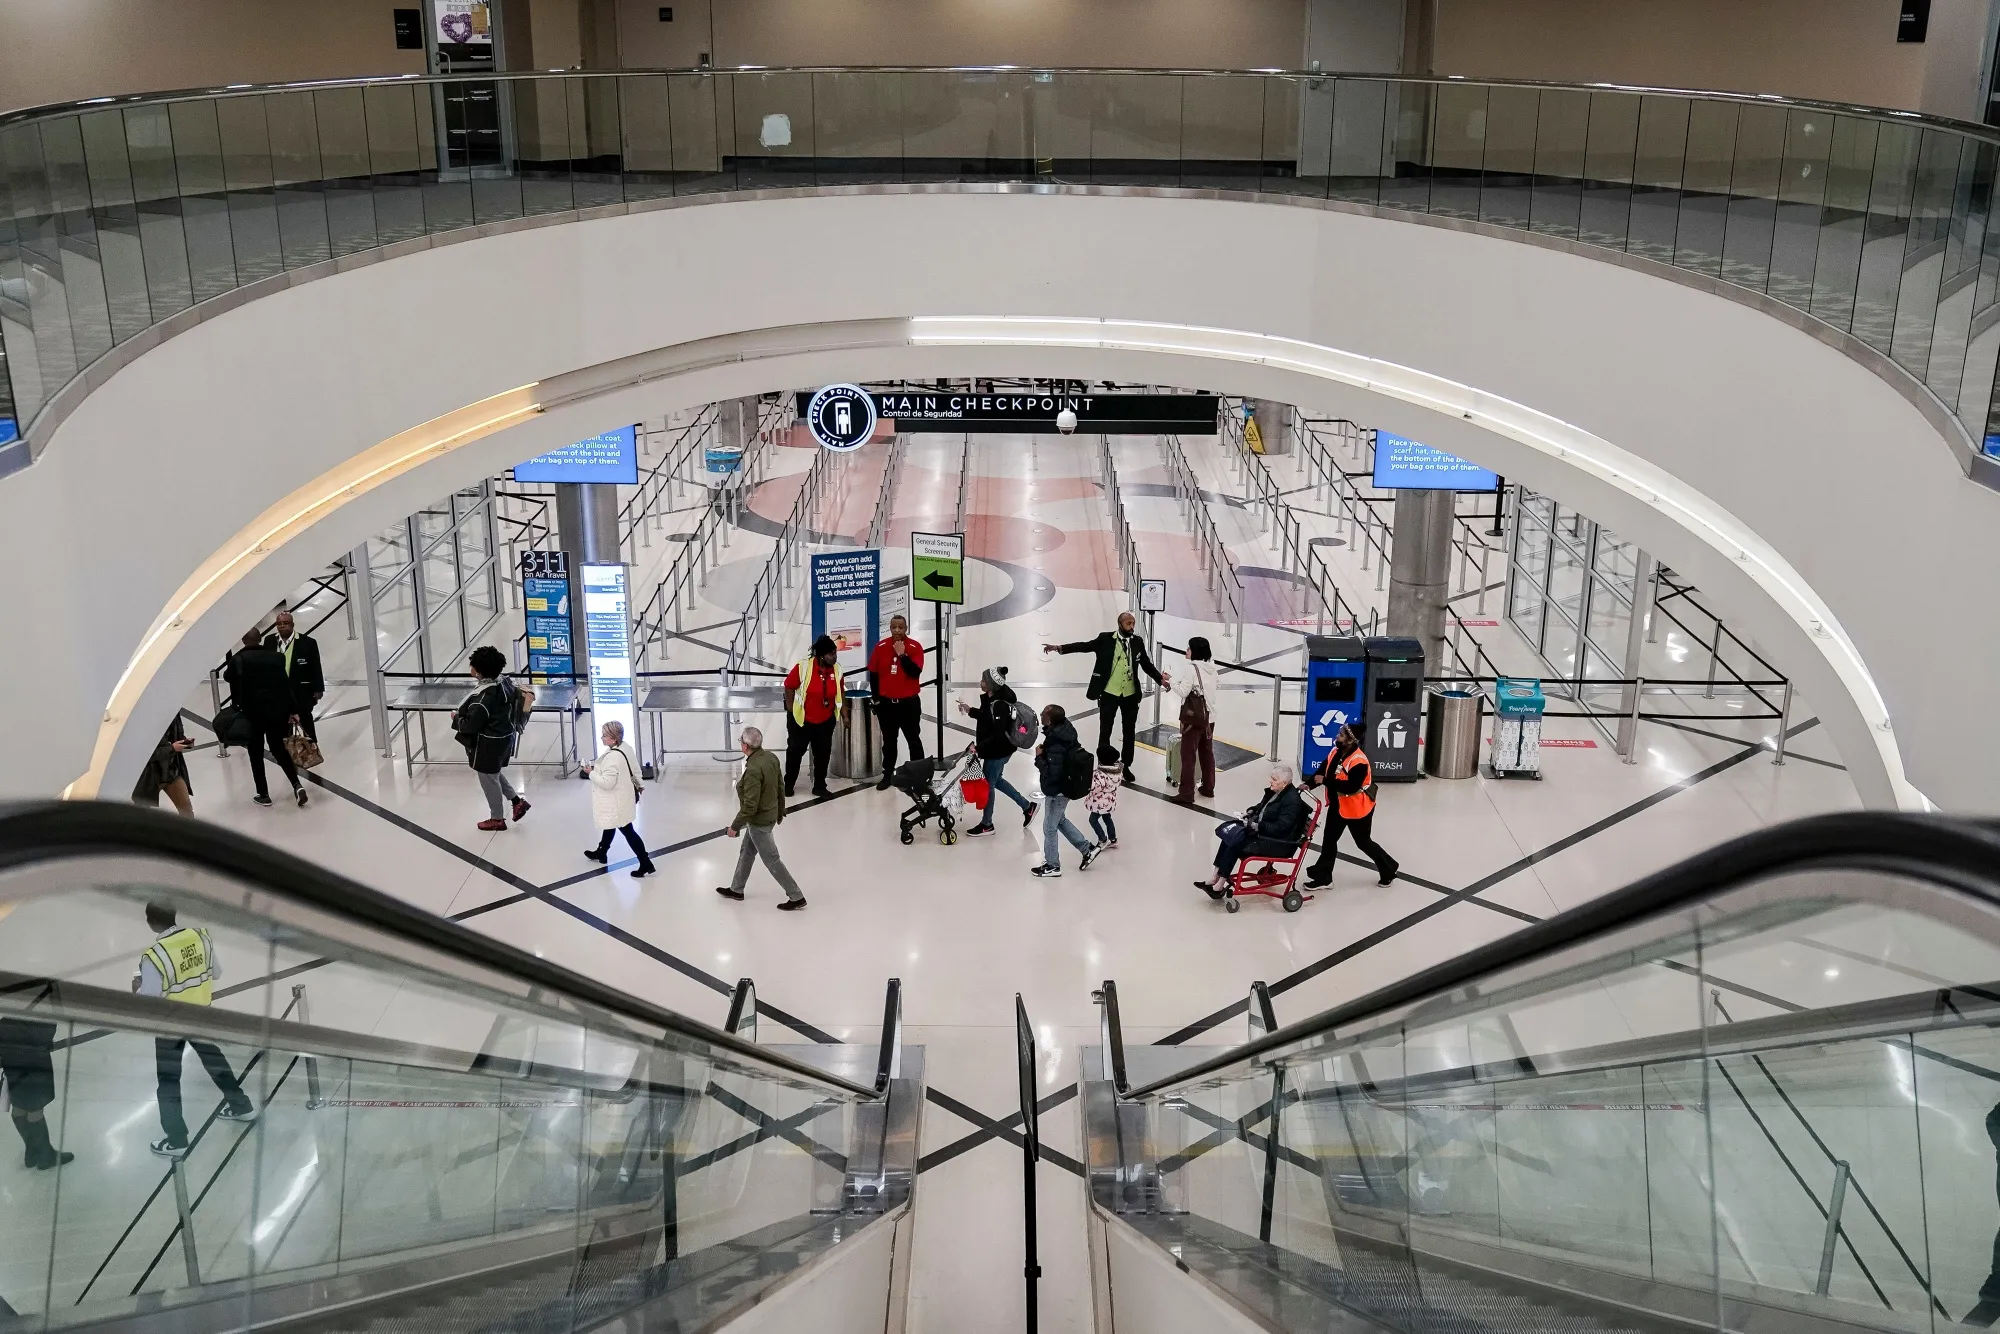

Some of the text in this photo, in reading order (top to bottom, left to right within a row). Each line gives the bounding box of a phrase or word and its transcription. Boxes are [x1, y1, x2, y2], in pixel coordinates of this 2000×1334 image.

[882, 396, 1094, 411] MAIN CHECKPOINT
[813, 388, 860, 447] MAIN CHECK POINT
[882, 409, 963, 419] Control de Seguridad
[604, 435, 623, 443] coat,
[585, 441, 608, 450] pillow
[1393, 447, 1413, 455] scarf,
[1415, 447, 1429, 455] hat,
[580, 449, 592, 457] the
[593, 449, 606, 457] bin
[606, 449, 621, 457] and
[529, 457, 547, 465] your
[548, 456, 563, 465] bag
[574, 457, 588, 466] top
[589, 457, 598, 465] of
[599, 457, 620, 465] them.
[1390, 463, 1408, 471] your
[1409, 463, 1423, 471] bag
[1436, 464, 1449, 472] top
[1450, 463, 1459, 471] of
[1459, 463, 1481, 471] them.
[915, 537, 959, 548] General Security
[924, 547, 951, 557] Screening
[523, 550, 567, 573] 3-1-1
[818, 559, 834, 567] Now
[860, 555, 873, 563] add
[815, 568, 831, 576] your
[831, 565, 855, 573] driver's
[825, 573, 854, 582] Samsung
[854, 571, 875, 579] Wallet
[528, 580, 537, 593] 3
[817, 582, 830, 590] and
[842, 580, 848, 588] it
[855, 579, 874, 587] select
[820, 587, 872, 598] TSA checkpoints.
[1374, 761, 1403, 770] TRASH
